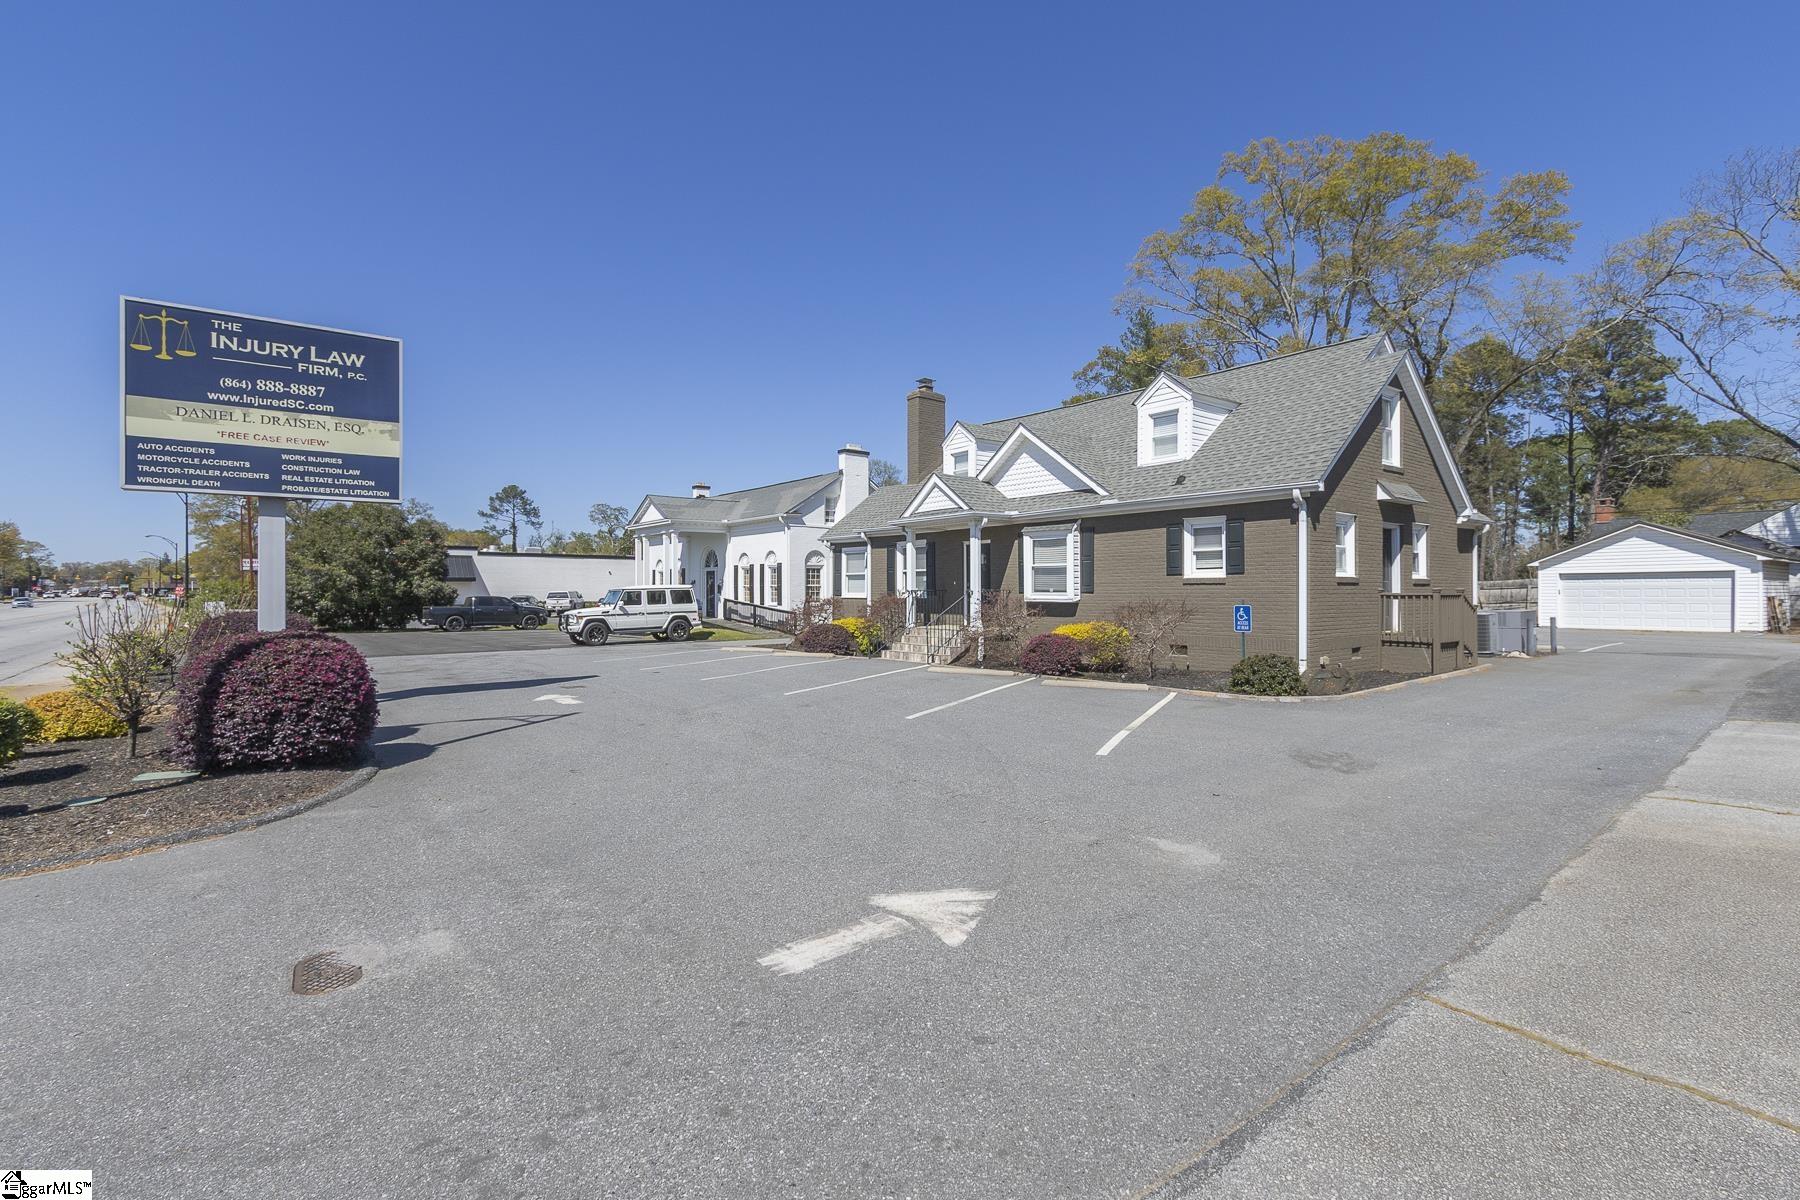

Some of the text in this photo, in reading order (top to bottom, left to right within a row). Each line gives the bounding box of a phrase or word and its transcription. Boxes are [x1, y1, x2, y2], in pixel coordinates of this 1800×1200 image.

[211, 320, 242, 332] THE
[210, 332, 365, 368] INJURY LAW
[298, 363, 367, 381] FIRM, P.C.
[220, 377, 325, 398] (864) 888-8887
[208, 392, 334, 412] www.InjuredSC.com
[176, 406, 238, 422] DANIEL
[243, 414, 255, 424] L.
[261, 415, 330, 432] DRAISEN,
[254, 434, 281, 443] CASE
[164, 445, 215, 454] ACCIDENTS
[137, 454, 250, 468] MOTORCYCLE ACCIDENTS
[308, 456, 342, 464] INJURIES
[137, 465, 270, 479] TRACTOR-TRAILER ACCIDENTS
[282, 465, 342, 474] CONSTRUCTION
[137, 476, 190, 485] WRONGFUL
[335, 478, 375, 486] LITIGATION
[282, 485, 348, 494] PROBATE/ESTATE
